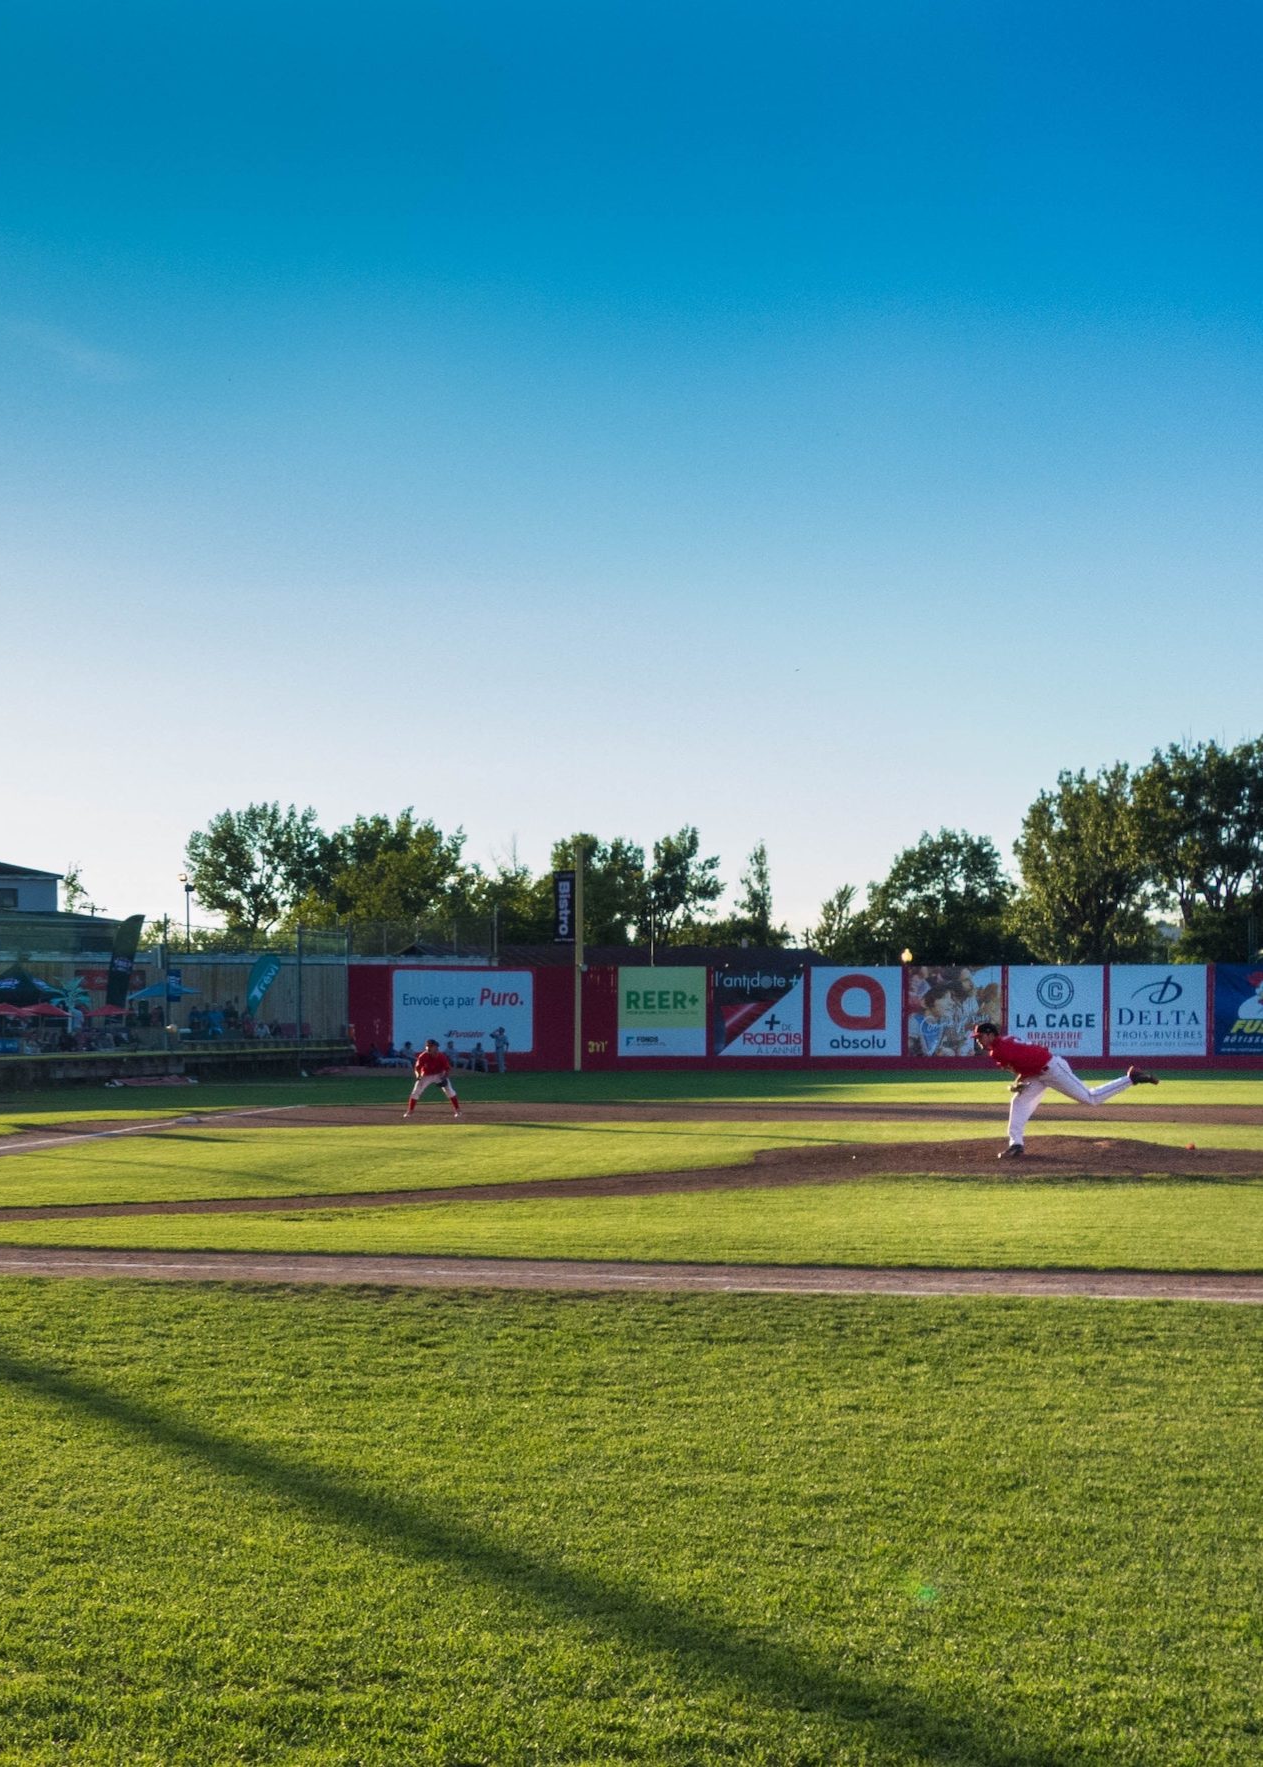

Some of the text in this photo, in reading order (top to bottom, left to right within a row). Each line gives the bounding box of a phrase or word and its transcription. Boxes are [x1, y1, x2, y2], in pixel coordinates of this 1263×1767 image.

[558, 881, 571, 936] Bistro
[402, 987, 524, 1009] Envoie ça par Puro.
[625, 990, 699, 1009] REER+
[1016, 1013, 1096, 1028] LA CAGE
[1117, 1007, 1201, 1026] DELTA
[829, 1035, 886, 1049] absolu
[1027, 1031, 1083, 1040] BRASSERIE
[1116, 1028, 1204, 1040] TROIS-RIVIÈRES
